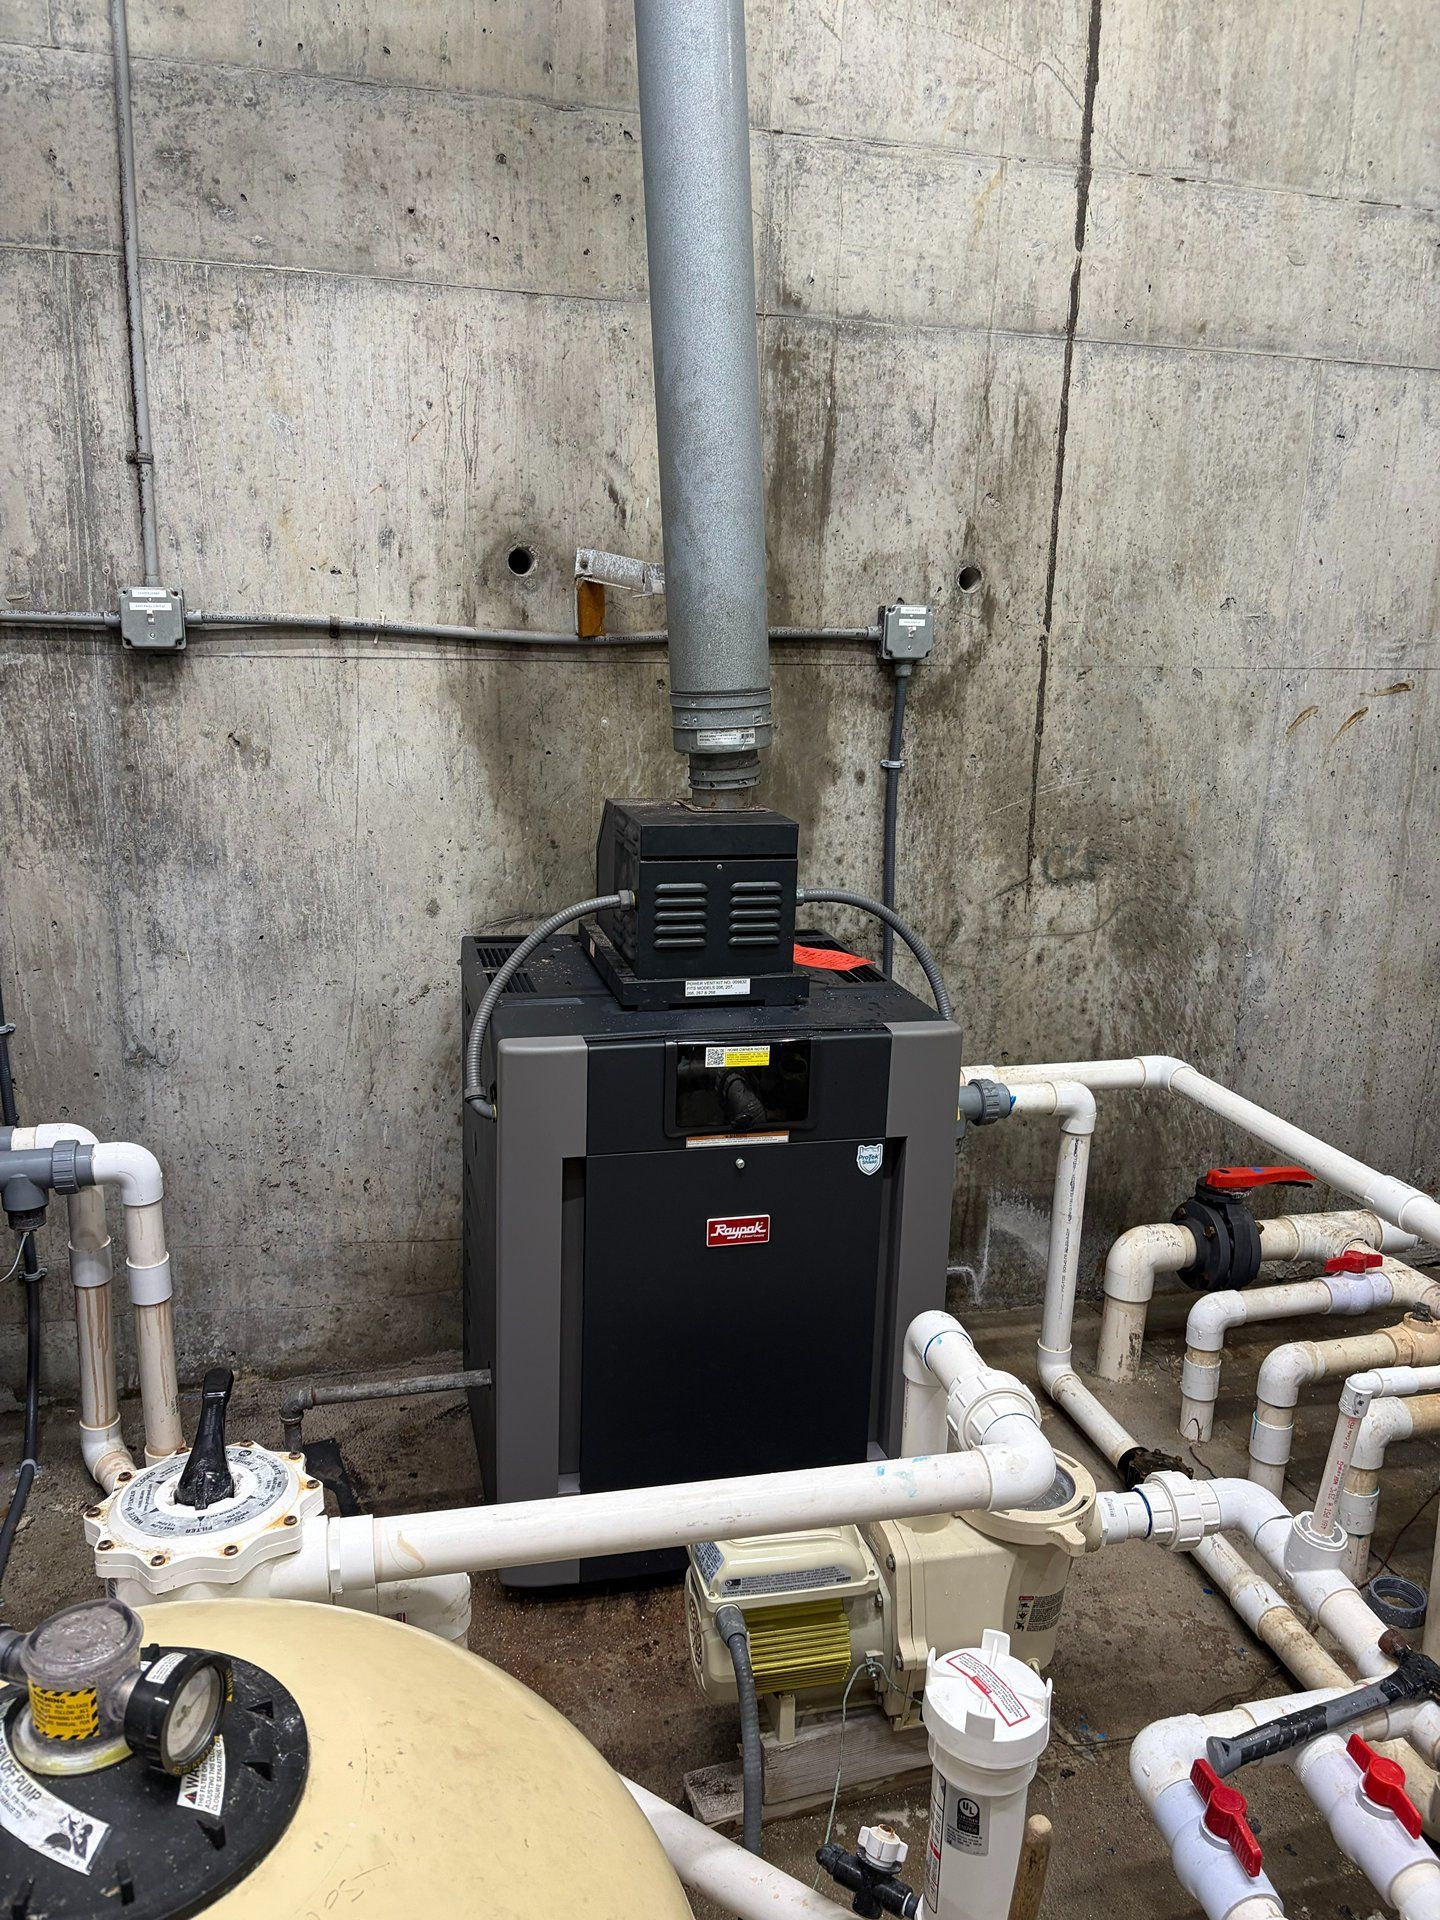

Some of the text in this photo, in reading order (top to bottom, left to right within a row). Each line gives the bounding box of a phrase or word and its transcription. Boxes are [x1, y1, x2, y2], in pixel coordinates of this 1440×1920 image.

[710, 1221, 766, 1240] Raypak
[135, 1471, 156, 1488] CLOSED
[128, 1512, 144, 1526] WASTE
[1323, 1507, 1332, 1518] PSI
[186, 1525, 213, 1534] FILTER
[1, 1758, 20, 1778] OFF
[14, 1774, 42, 1802] PUMP
[204, 1776, 214, 1808] ADJUSTING
[211, 1783, 220, 1811] CLOSURE
[962, 1801, 974, 1816] UL
